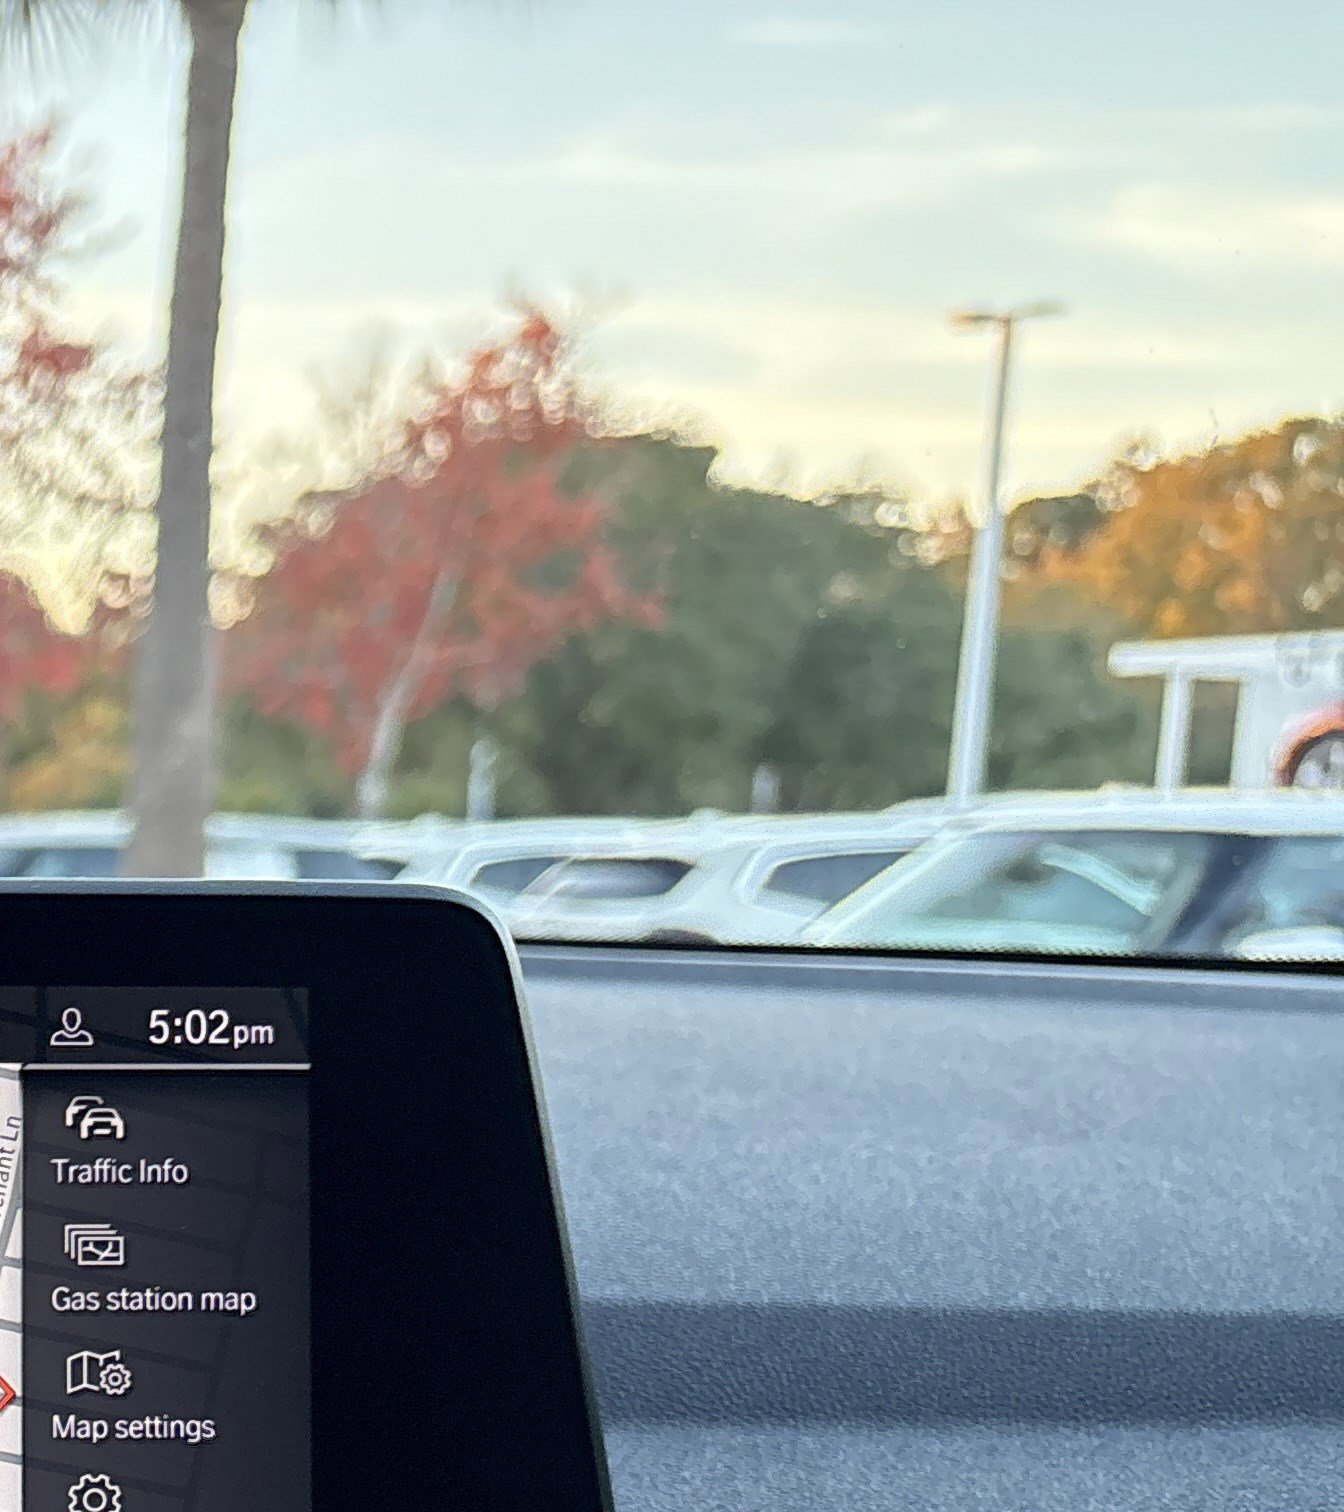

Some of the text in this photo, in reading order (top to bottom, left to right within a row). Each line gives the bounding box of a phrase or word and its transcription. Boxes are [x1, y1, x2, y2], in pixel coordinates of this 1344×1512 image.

[0, 1115, 22, 1141] Ln
[50, 1158, 189, 1183] Traffic Info
[51, 1285, 257, 1316] Gas station map
[52, 1414, 216, 1443] Map settings
